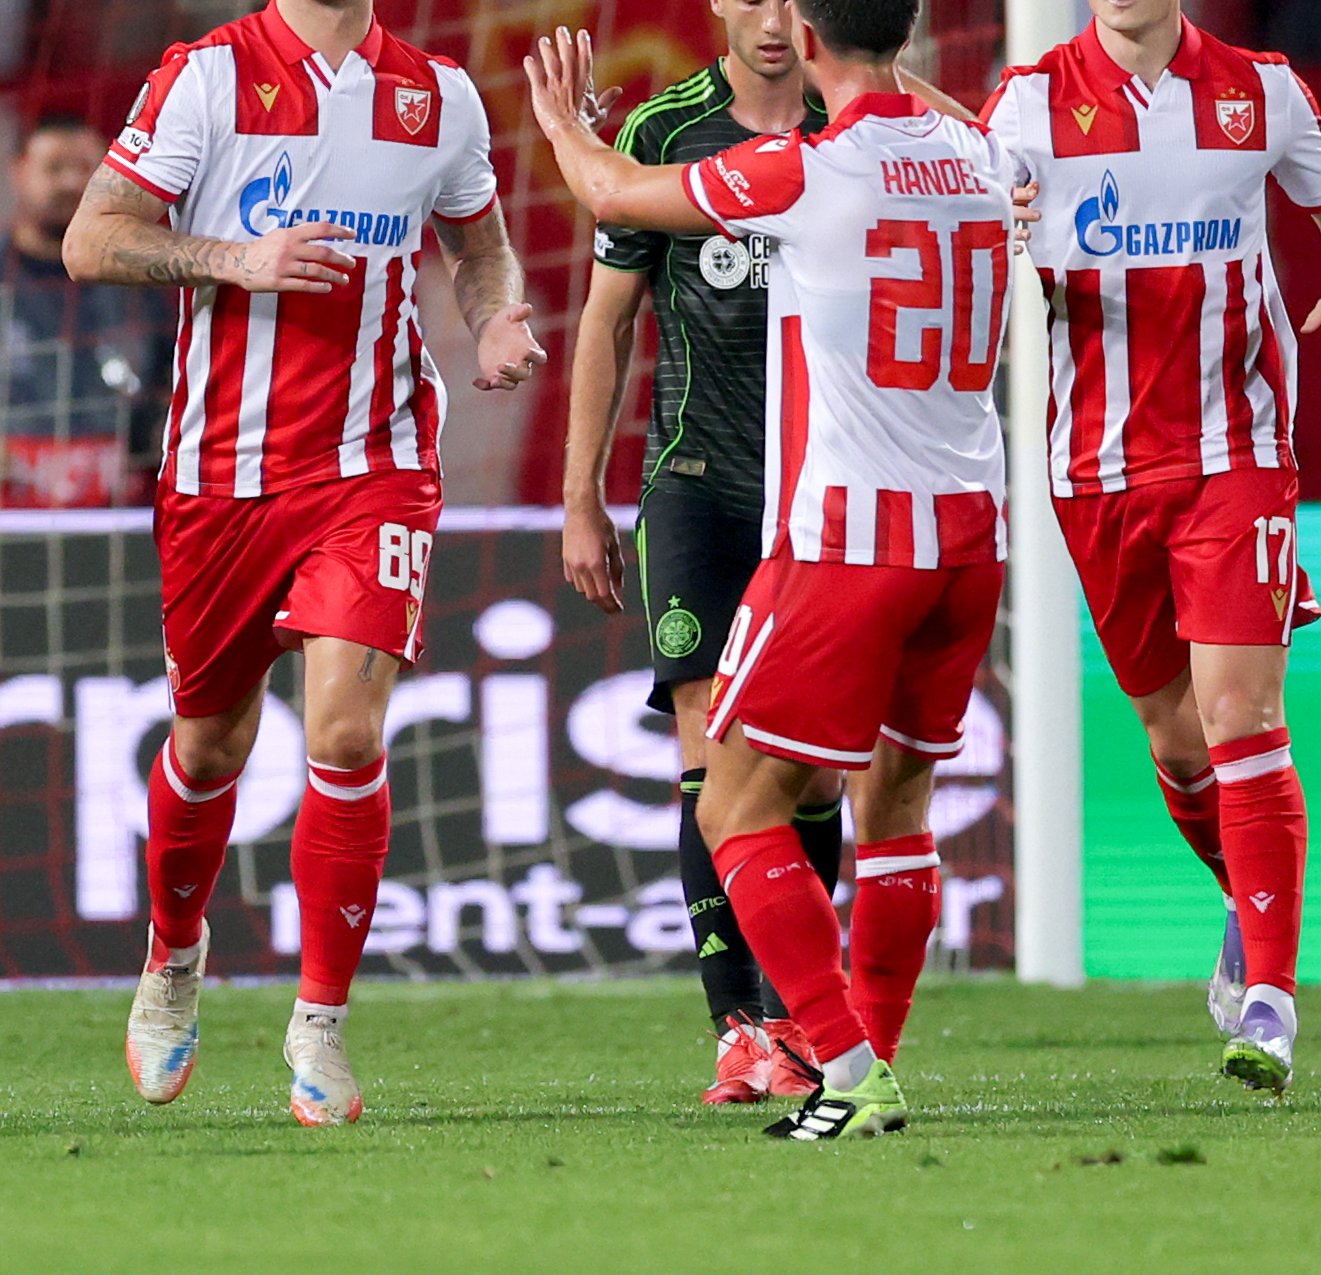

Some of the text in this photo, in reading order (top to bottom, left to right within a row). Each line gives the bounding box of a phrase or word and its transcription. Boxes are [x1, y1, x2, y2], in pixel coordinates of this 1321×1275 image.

[881, 157, 989, 196] HÄNDEL
[1126, 217, 1242, 256] GAZPROM
[865, 219, 1009, 391] 20
[378, 521, 433, 602] 89
[1253, 515, 1292, 585] 17
